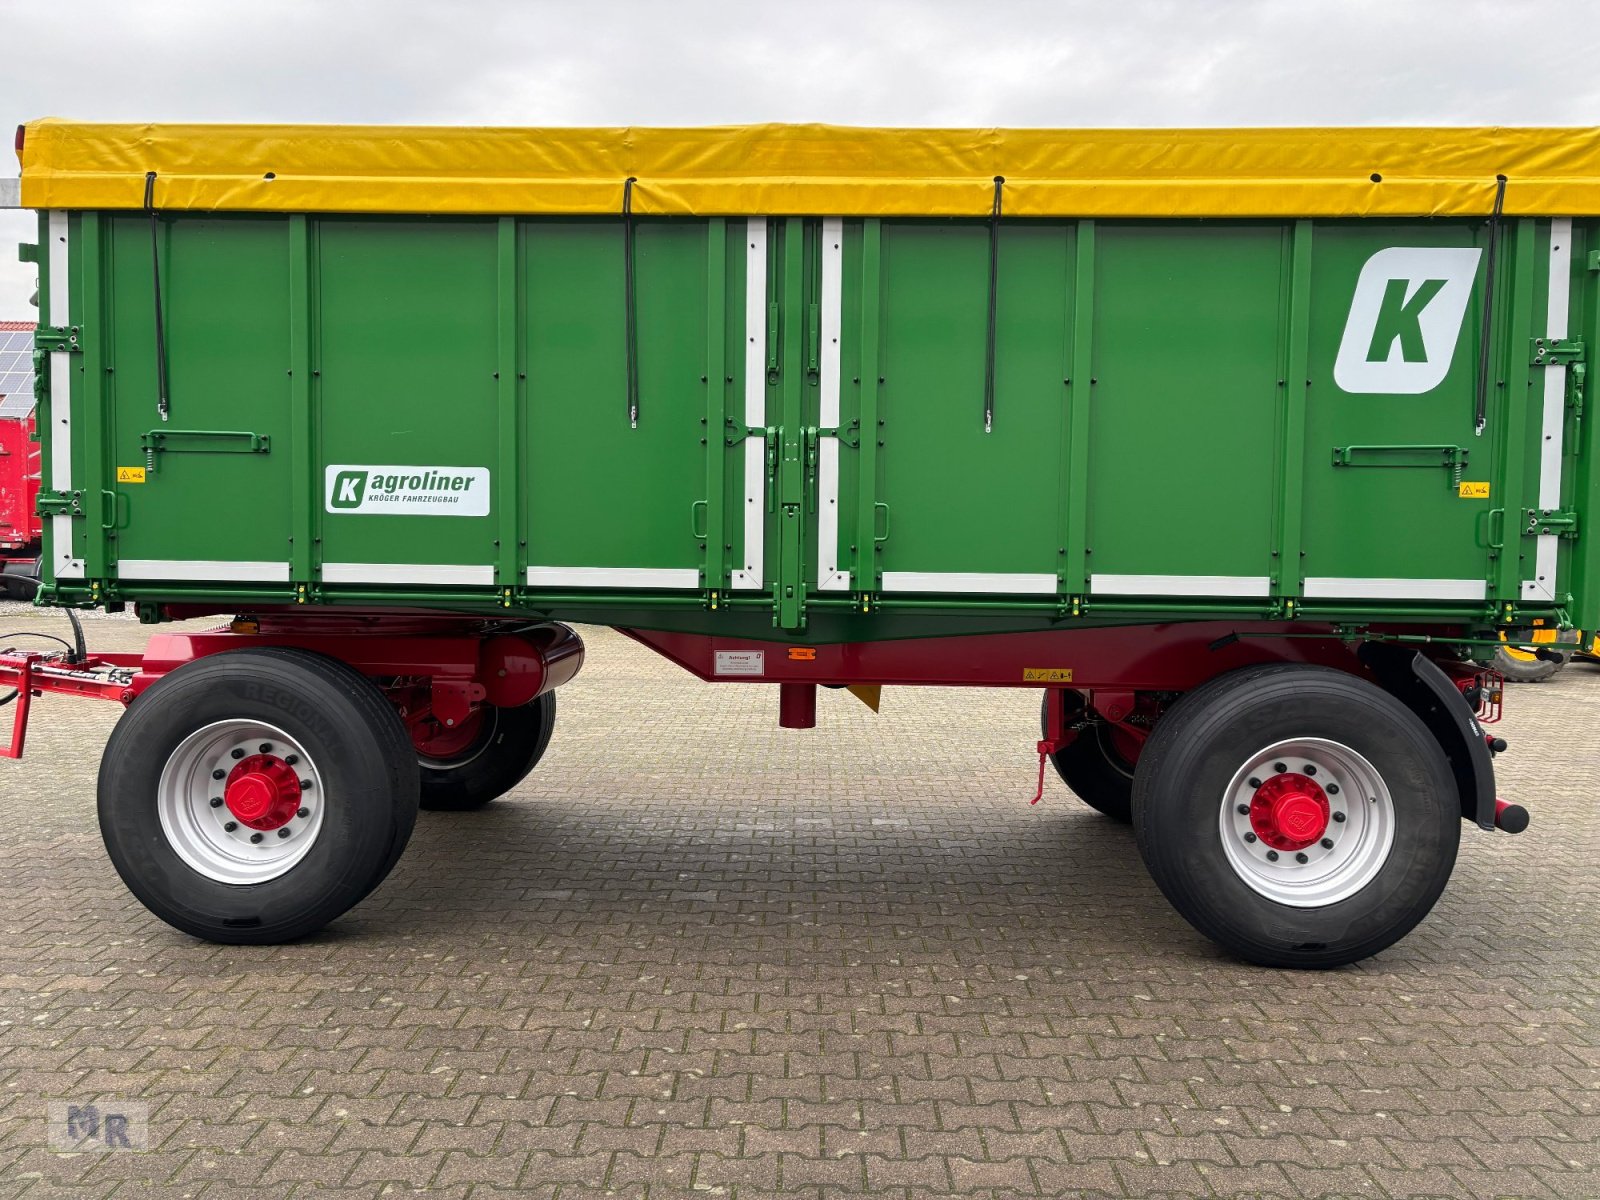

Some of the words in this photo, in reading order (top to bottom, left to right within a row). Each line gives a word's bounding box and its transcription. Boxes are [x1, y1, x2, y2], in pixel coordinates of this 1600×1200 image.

[1365, 278, 1449, 363] K
[338, 478, 361, 502] K
[370, 470, 475, 494] agroliner
[368, 494, 400, 502] KRÖGER
[402, 495, 459, 504] FAHRZEUGBAU
